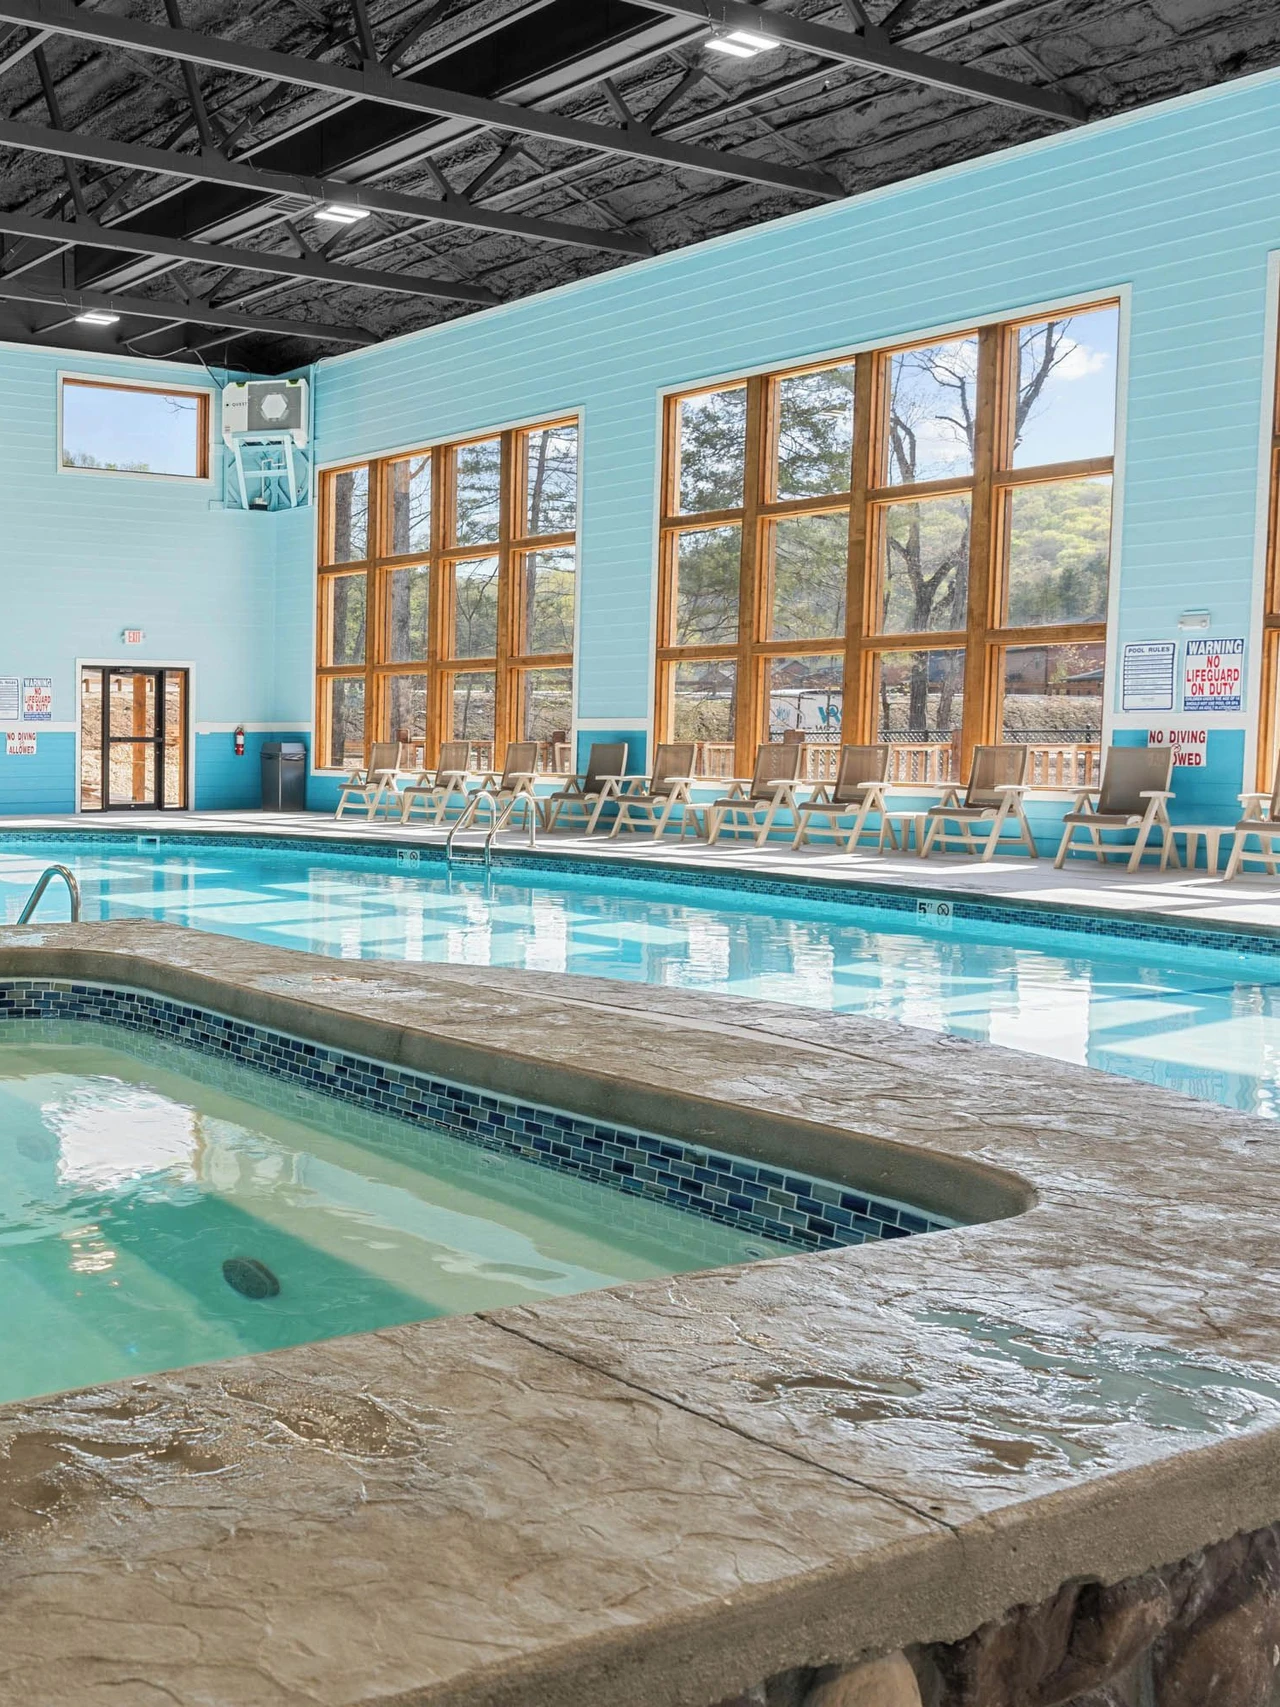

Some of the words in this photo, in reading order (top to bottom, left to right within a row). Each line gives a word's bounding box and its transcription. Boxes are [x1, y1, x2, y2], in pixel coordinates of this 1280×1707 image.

[128, 631, 140, 643] EXIT
[1188, 640, 1242, 655] WARNING
[1206, 655, 1220, 668] NO
[1186, 669, 1240, 682] LIFEGUARD
[24, 678, 52, 687] WARNING
[1191, 683, 1205, 695] ON
[1209, 682, 1234, 695] DUTY
[7, 732, 15, 740] NO
[18, 732, 36, 740] DIVING
[1149, 730, 1164, 744] NO
[1169, 730, 1206, 744] DIVING
[9, 746, 34, 754] ALLOWED
[918, 902, 927, 914] 5
